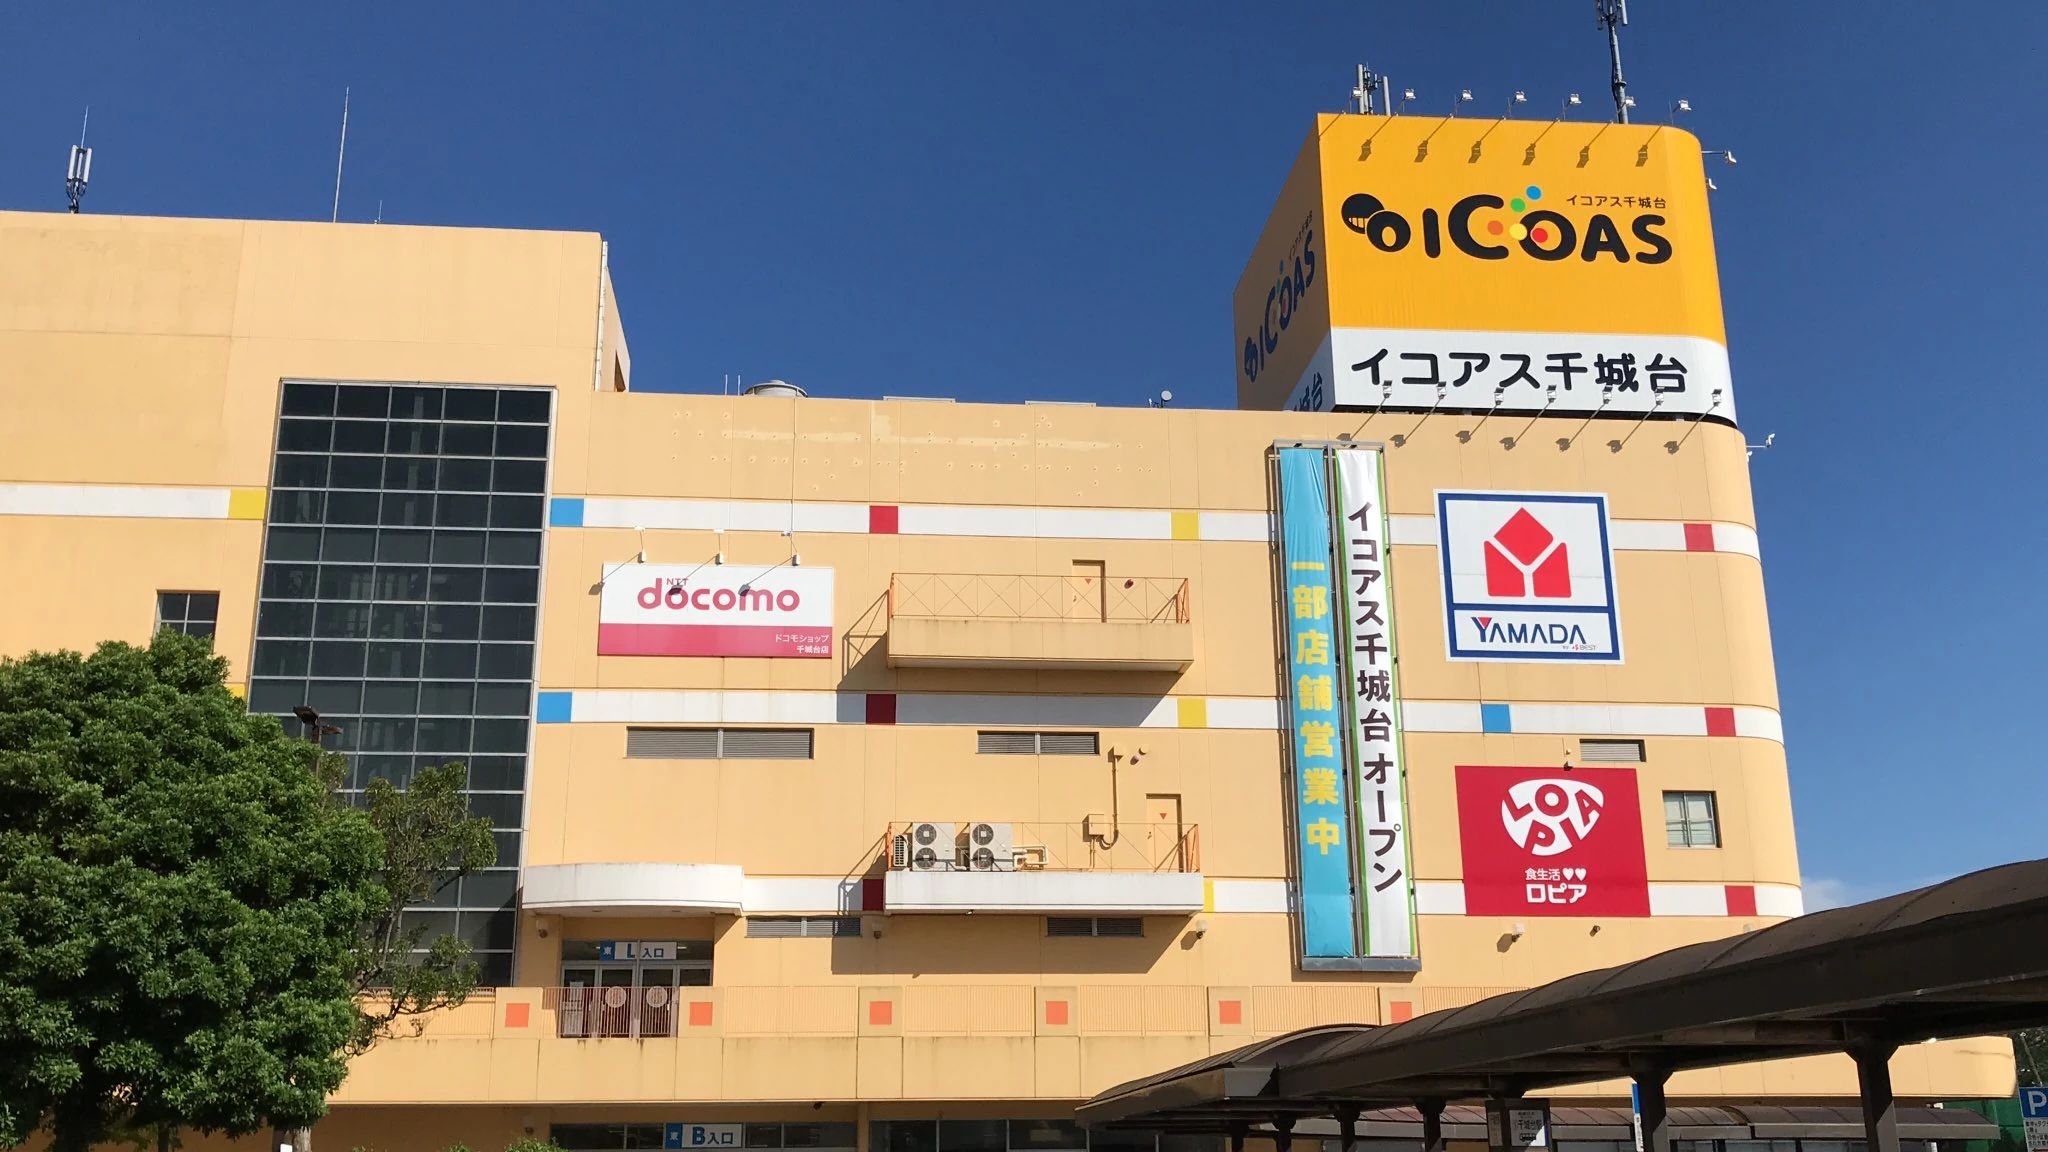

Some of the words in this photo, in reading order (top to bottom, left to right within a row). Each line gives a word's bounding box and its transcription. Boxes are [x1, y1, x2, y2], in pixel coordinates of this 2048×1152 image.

[1566, 194, 1667, 209] イコアス千城台
[1352, 348, 1689, 394] イコアス千城台
[637, 577, 800, 612] docomo
[666, 577, 689, 586] NTT
[775, 634, 830, 643] ドコモショップ
[1471, 616, 1587, 645] YAMADA
[796, 645, 830, 654] 千城台店
[1291, 560, 1341, 856] 一部店舗営業中
[1348, 501, 1404, 893] イコアス千城台オープン
[1502, 779, 1604, 856] LOPIA
[1524, 867, 1561, 882] 食生活
[1525, 882, 1588, 904] ロピア
[2027, 1090, 2048, 1116] P
